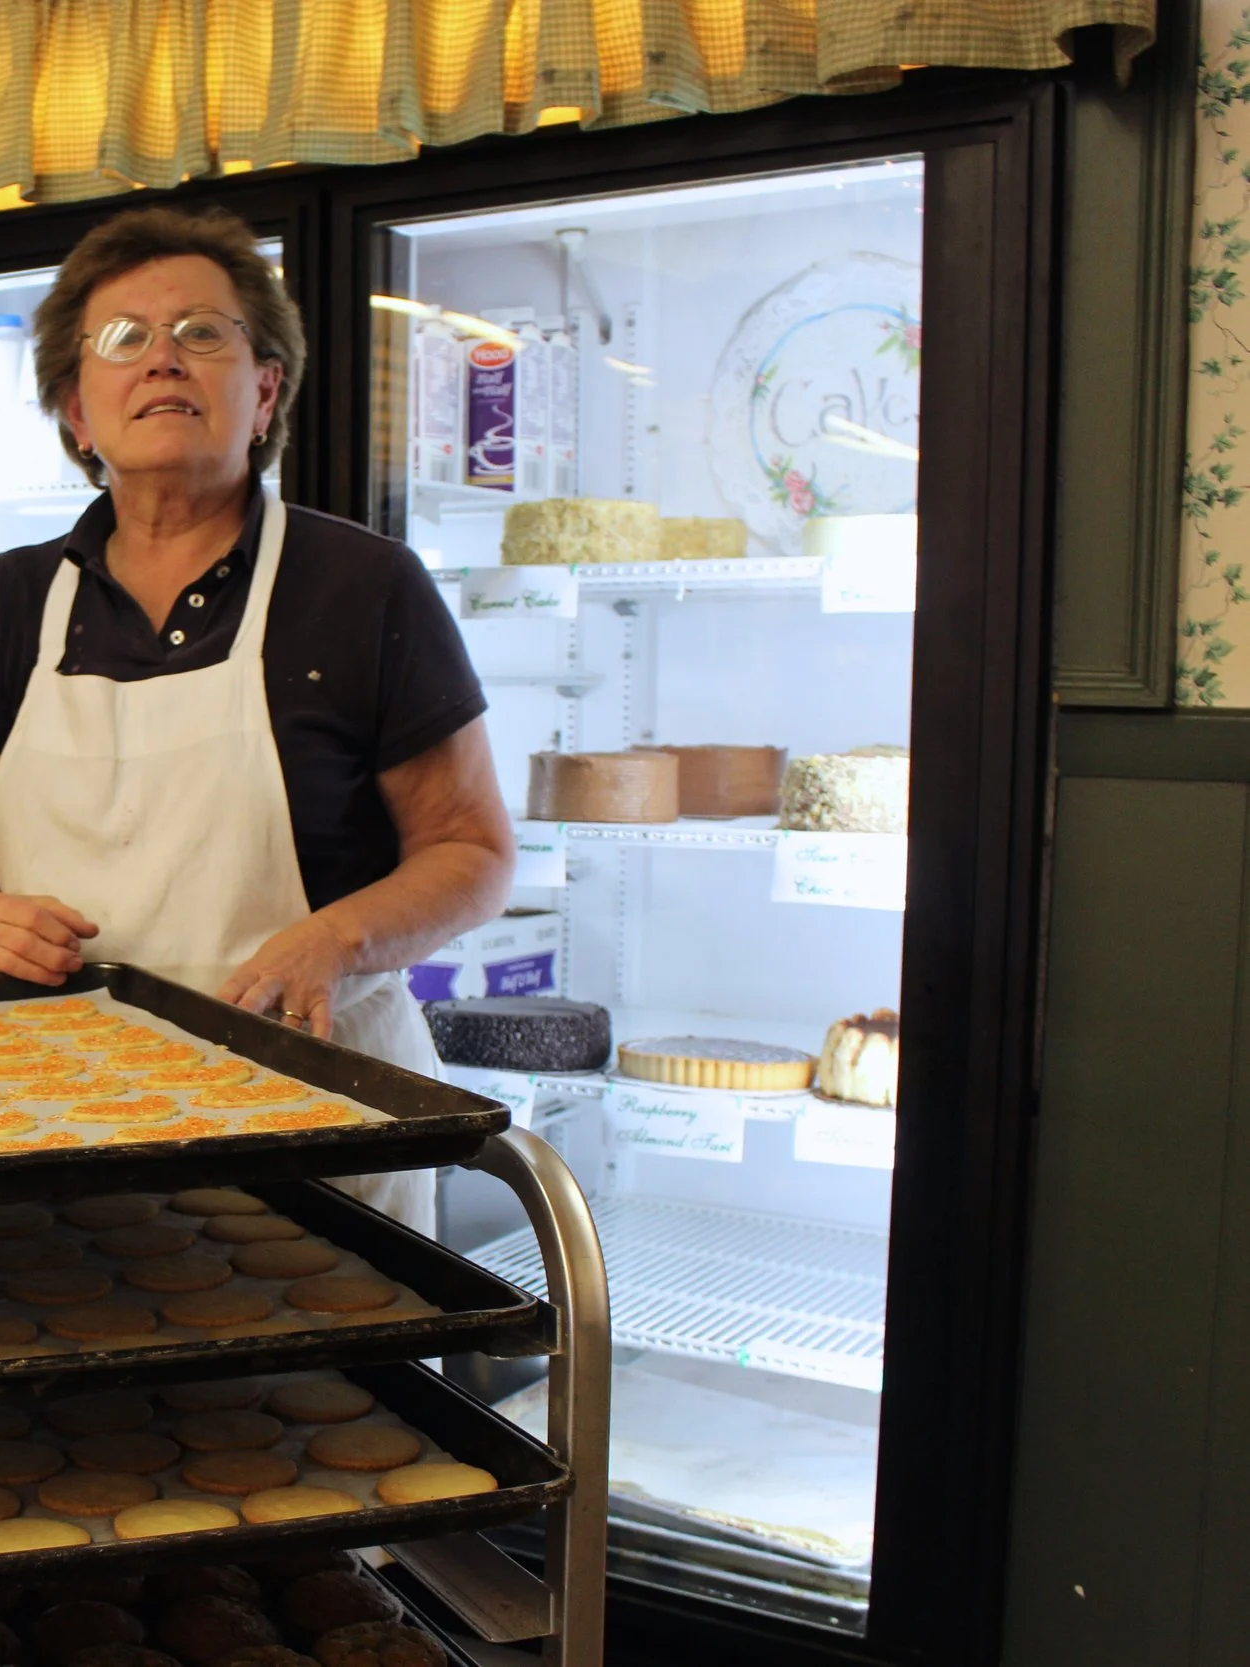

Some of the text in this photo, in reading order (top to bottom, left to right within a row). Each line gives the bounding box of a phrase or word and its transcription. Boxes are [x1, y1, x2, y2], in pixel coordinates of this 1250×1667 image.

[617, 1094, 699, 1124] Raspberry
[615, 1126, 735, 1154] Almond Tart
